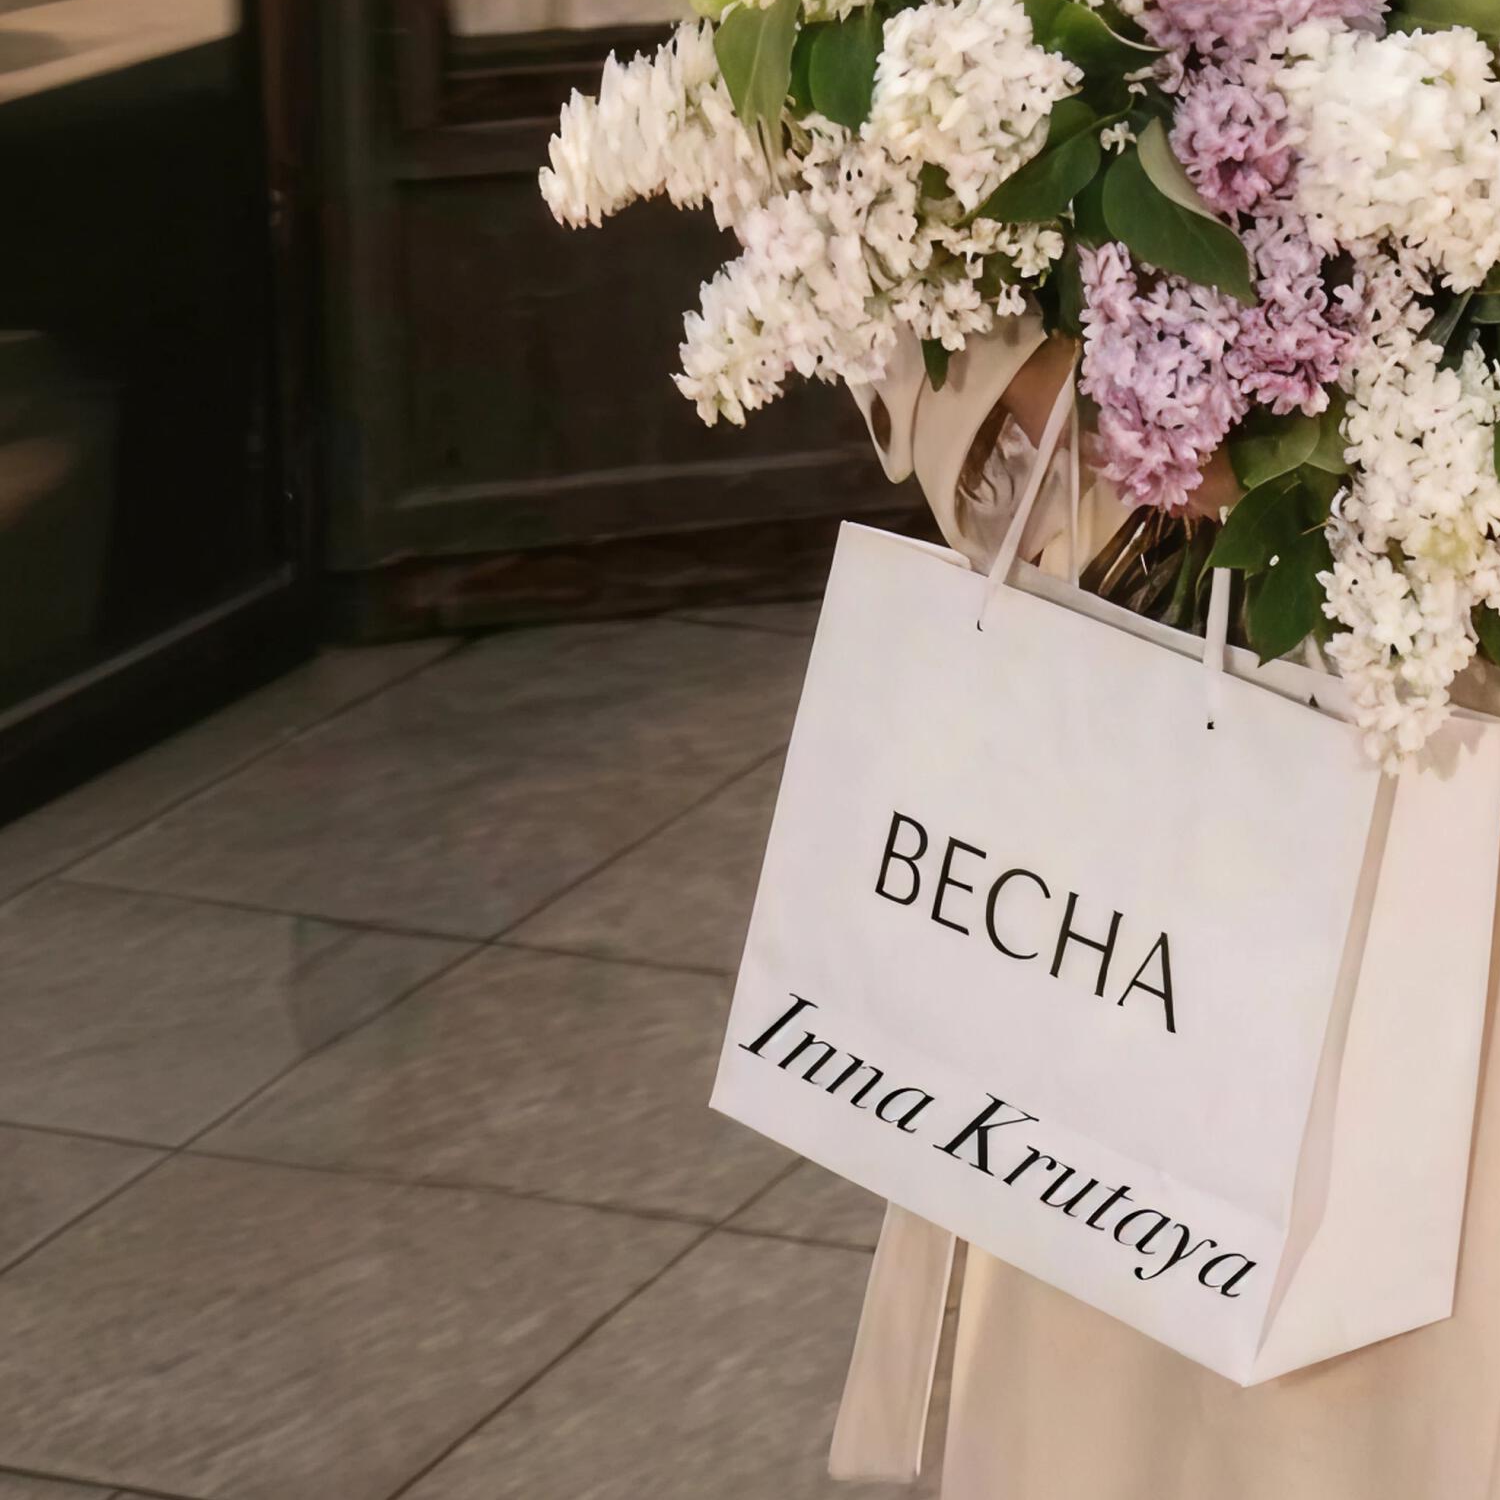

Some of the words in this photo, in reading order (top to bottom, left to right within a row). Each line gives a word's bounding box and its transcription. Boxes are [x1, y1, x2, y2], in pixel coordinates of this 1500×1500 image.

[874, 810, 1176, 1033] ВЕСНА
[738, 993, 935, 1134] Inna
[933, 1093, 1258, 1298] Krutaya
